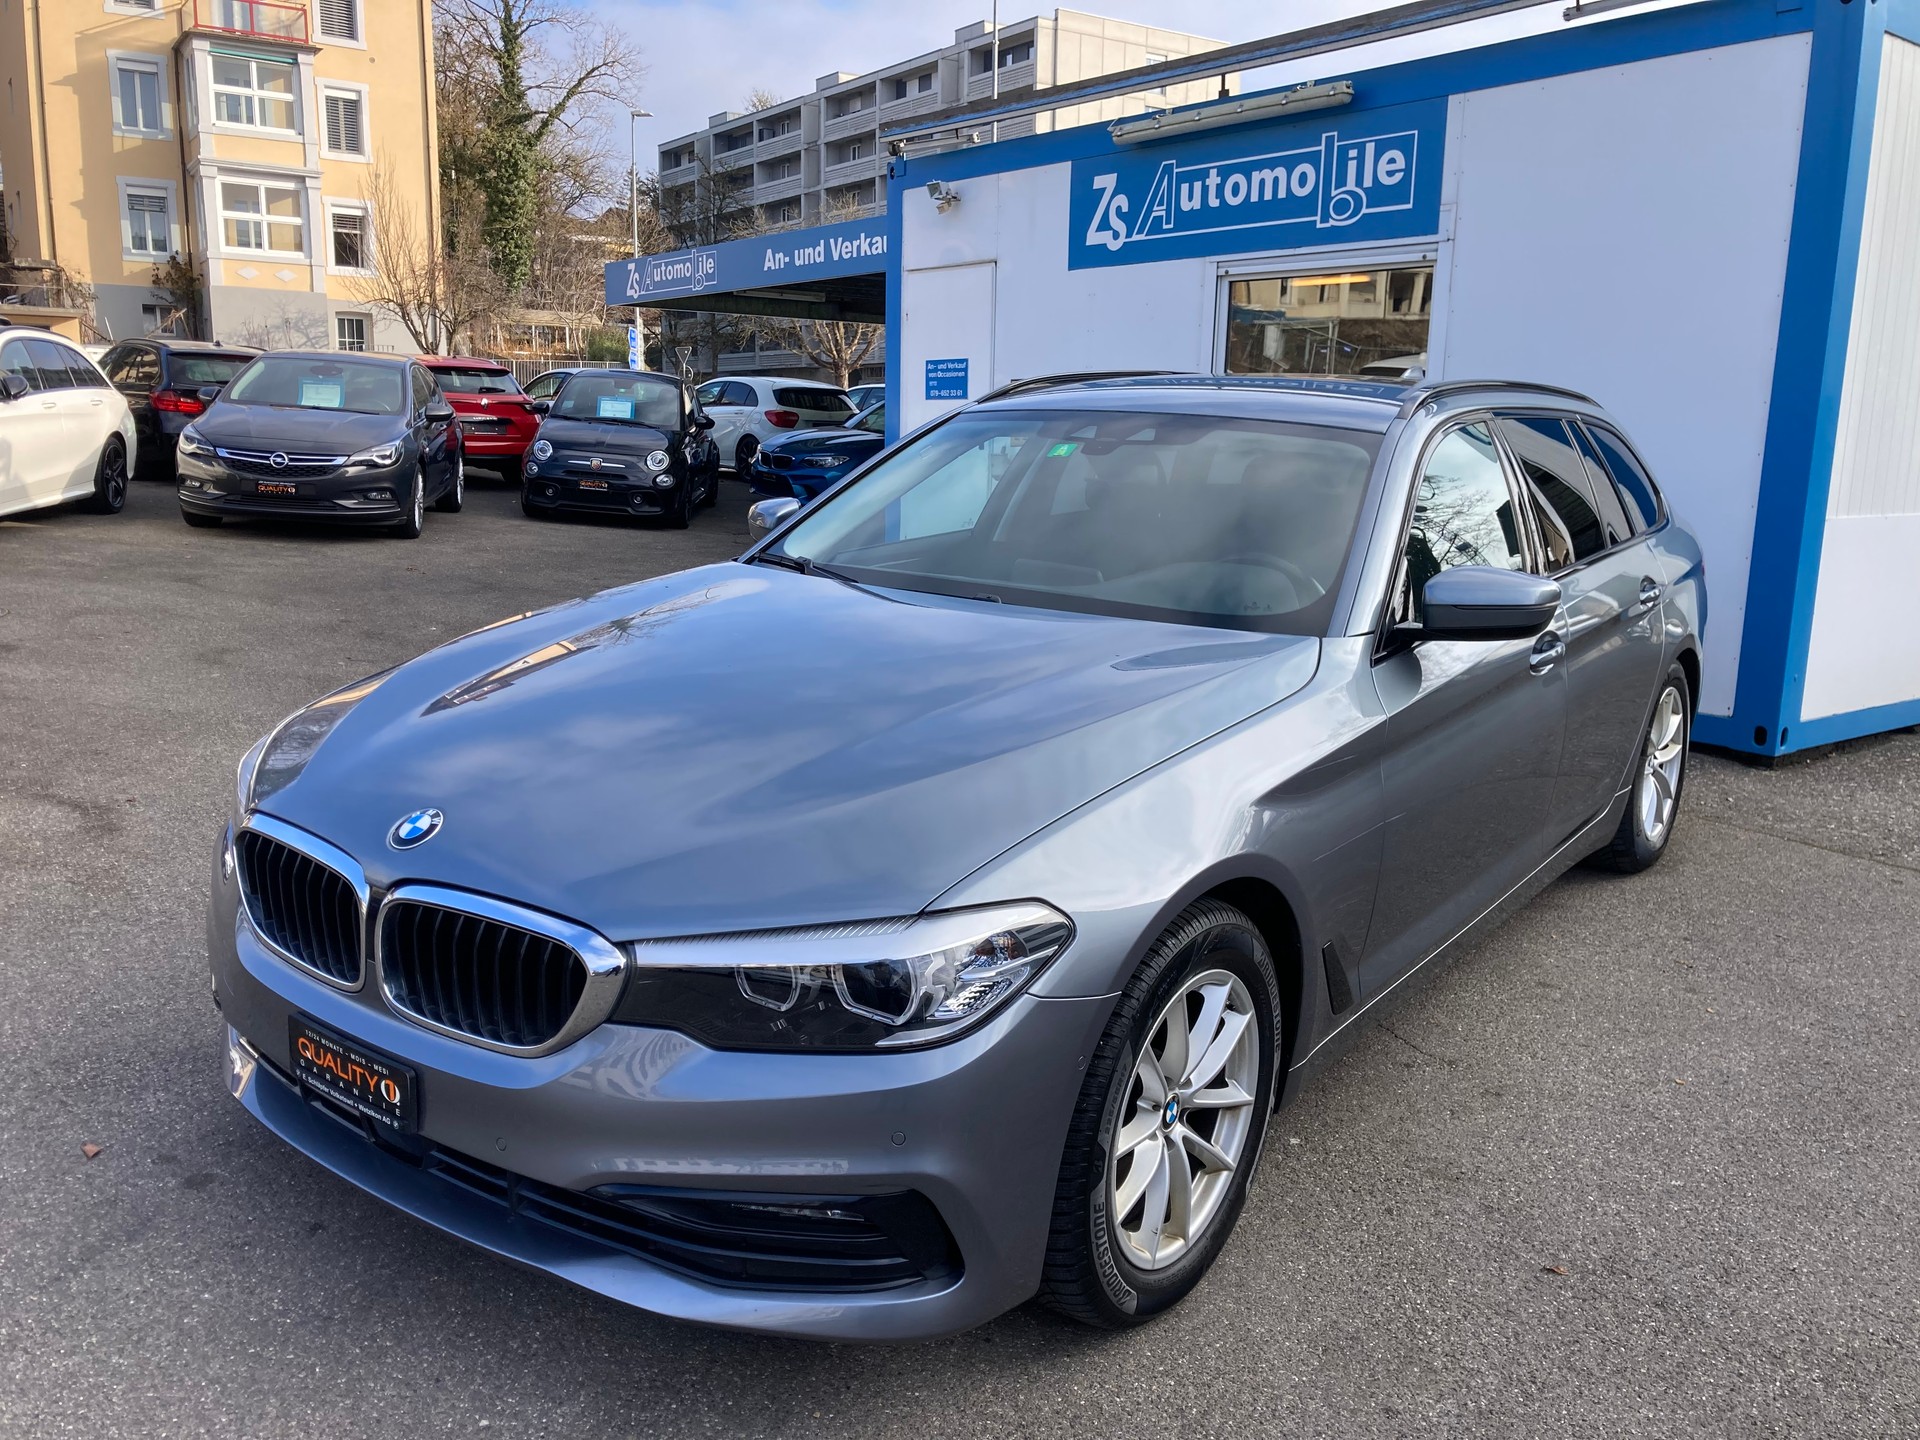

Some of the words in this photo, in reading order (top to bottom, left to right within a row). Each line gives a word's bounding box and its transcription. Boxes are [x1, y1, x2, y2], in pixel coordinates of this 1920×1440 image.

[1131, 131, 1406, 239] Automobile
[641, 250, 715, 294] Automobile
[763, 248, 790, 271] An-
[794, 240, 825, 266] und
[298, 1037, 379, 1093] QUALITY
[305, 1029, 320, 1041] 12/24
[321, 1039, 344, 1056] MONATE
[350, 1052, 366, 1066] MOIS
[373, 1063, 389, 1076] MESI
[300, 1058, 401, 1117] GARANTIE
[1091, 1201, 1132, 1308] BRIDGESTONE
